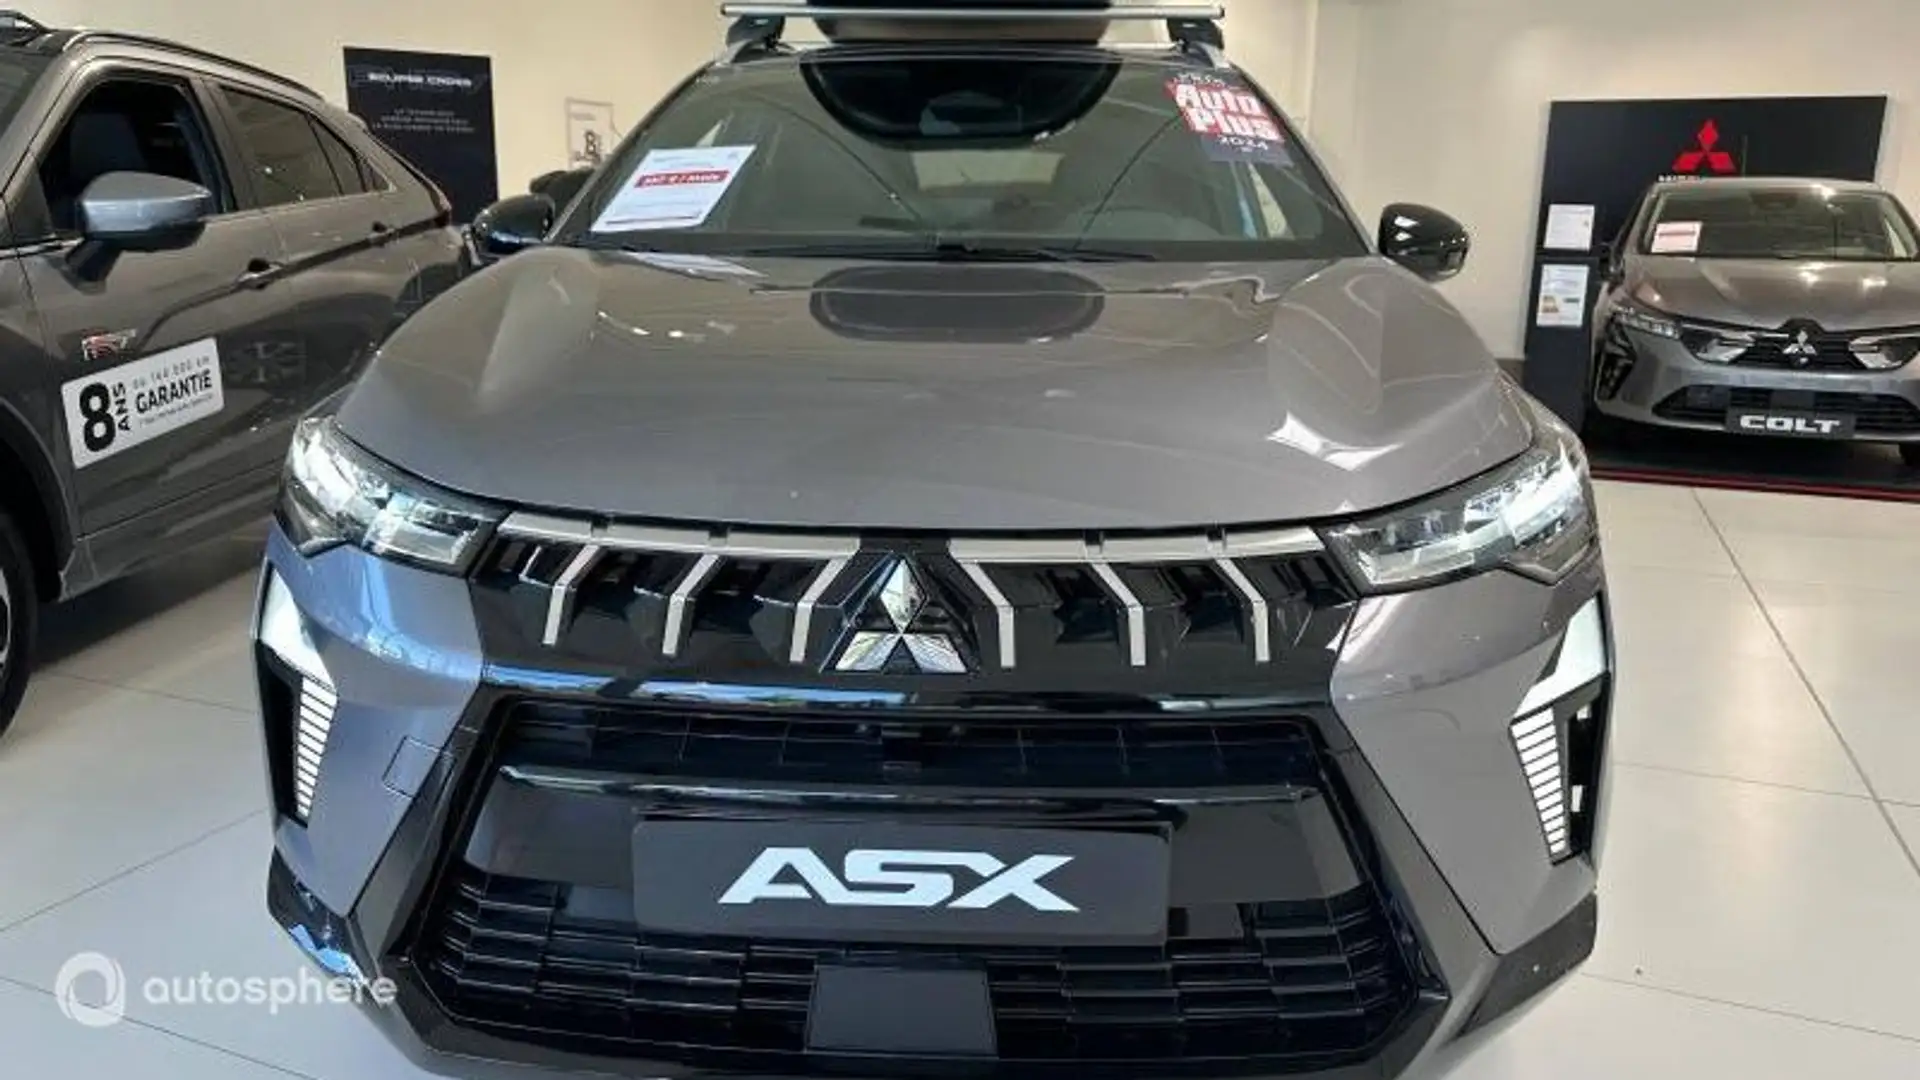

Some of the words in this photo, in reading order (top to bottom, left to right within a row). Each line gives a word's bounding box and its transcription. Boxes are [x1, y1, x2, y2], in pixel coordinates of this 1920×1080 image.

[1175, 84, 1264, 116] Auto
[1186, 107, 1281, 140] Plus
[112, 381, 131, 432] ANS
[135, 368, 213, 414] GARANTIE
[80, 382, 116, 452] 8
[1740, 414, 1840, 434] COLT
[717, 846, 1080, 911] ASX
